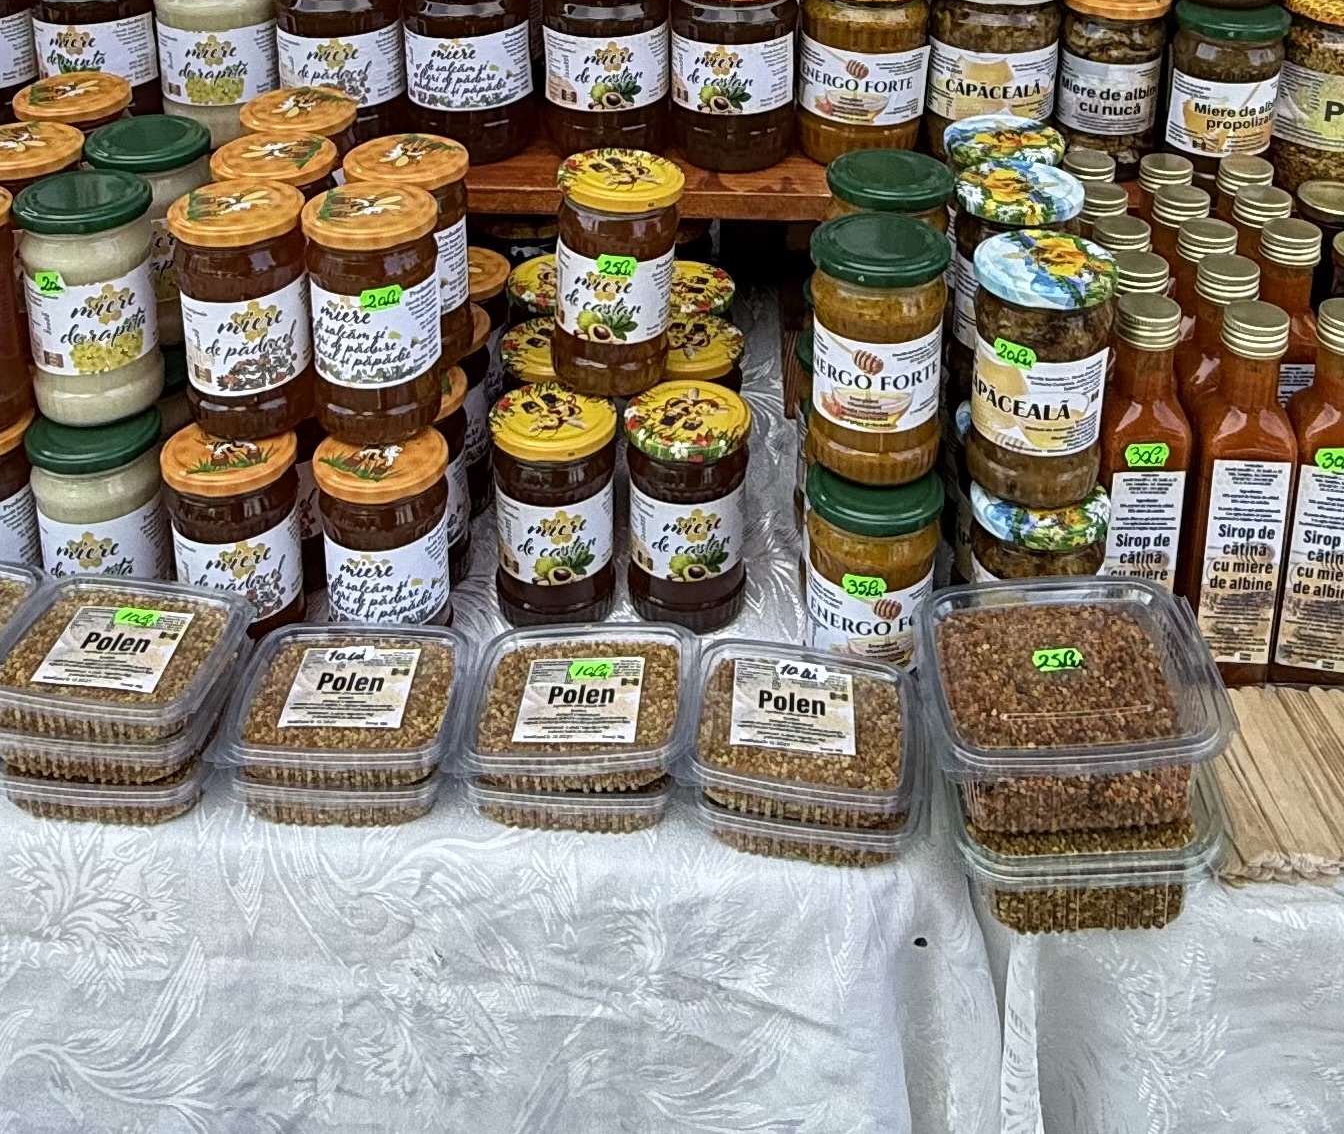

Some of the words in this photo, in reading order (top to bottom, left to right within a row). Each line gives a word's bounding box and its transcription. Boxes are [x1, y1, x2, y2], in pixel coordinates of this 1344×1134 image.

[802, 64, 858, 91] ENERGO
[864, 76, 914, 93] FORTE
[1061, 75, 1097, 98] Miere
[1100, 86, 1120, 100] de
[1079, 103, 1097, 115] cu
[1100, 102, 1141, 117] nucă
[1194, 102, 1233, 117] Miere
[1237, 106, 1259, 118] de
[72, 292, 136, 320] miere
[218, 310, 283, 335] miere
[813, 355, 871, 390] NERGO
[881, 360, 939, 391] FORTE
[1116, 533, 1150, 551] Sirop
[1154, 534, 1170, 548] de
[1218, 523, 1256, 542] Sirop
[1258, 525, 1276, 540] de
[1304, 529, 1342, 549] Sirop
[1213, 560, 1230, 573] cu
[1233, 558, 1274, 575] miere
[1297, 566, 1315, 579] cu
[1210, 575, 1227, 589] de
[1230, 575, 1273, 592] albine
[1293, 580, 1311, 595] de
[810, 602, 892, 637] ENERGO
[81, 631, 152, 654] Polen
[316, 672, 385, 694] Polen
[547, 684, 616, 705] Polen
[758, 690, 827, 716] Polen
